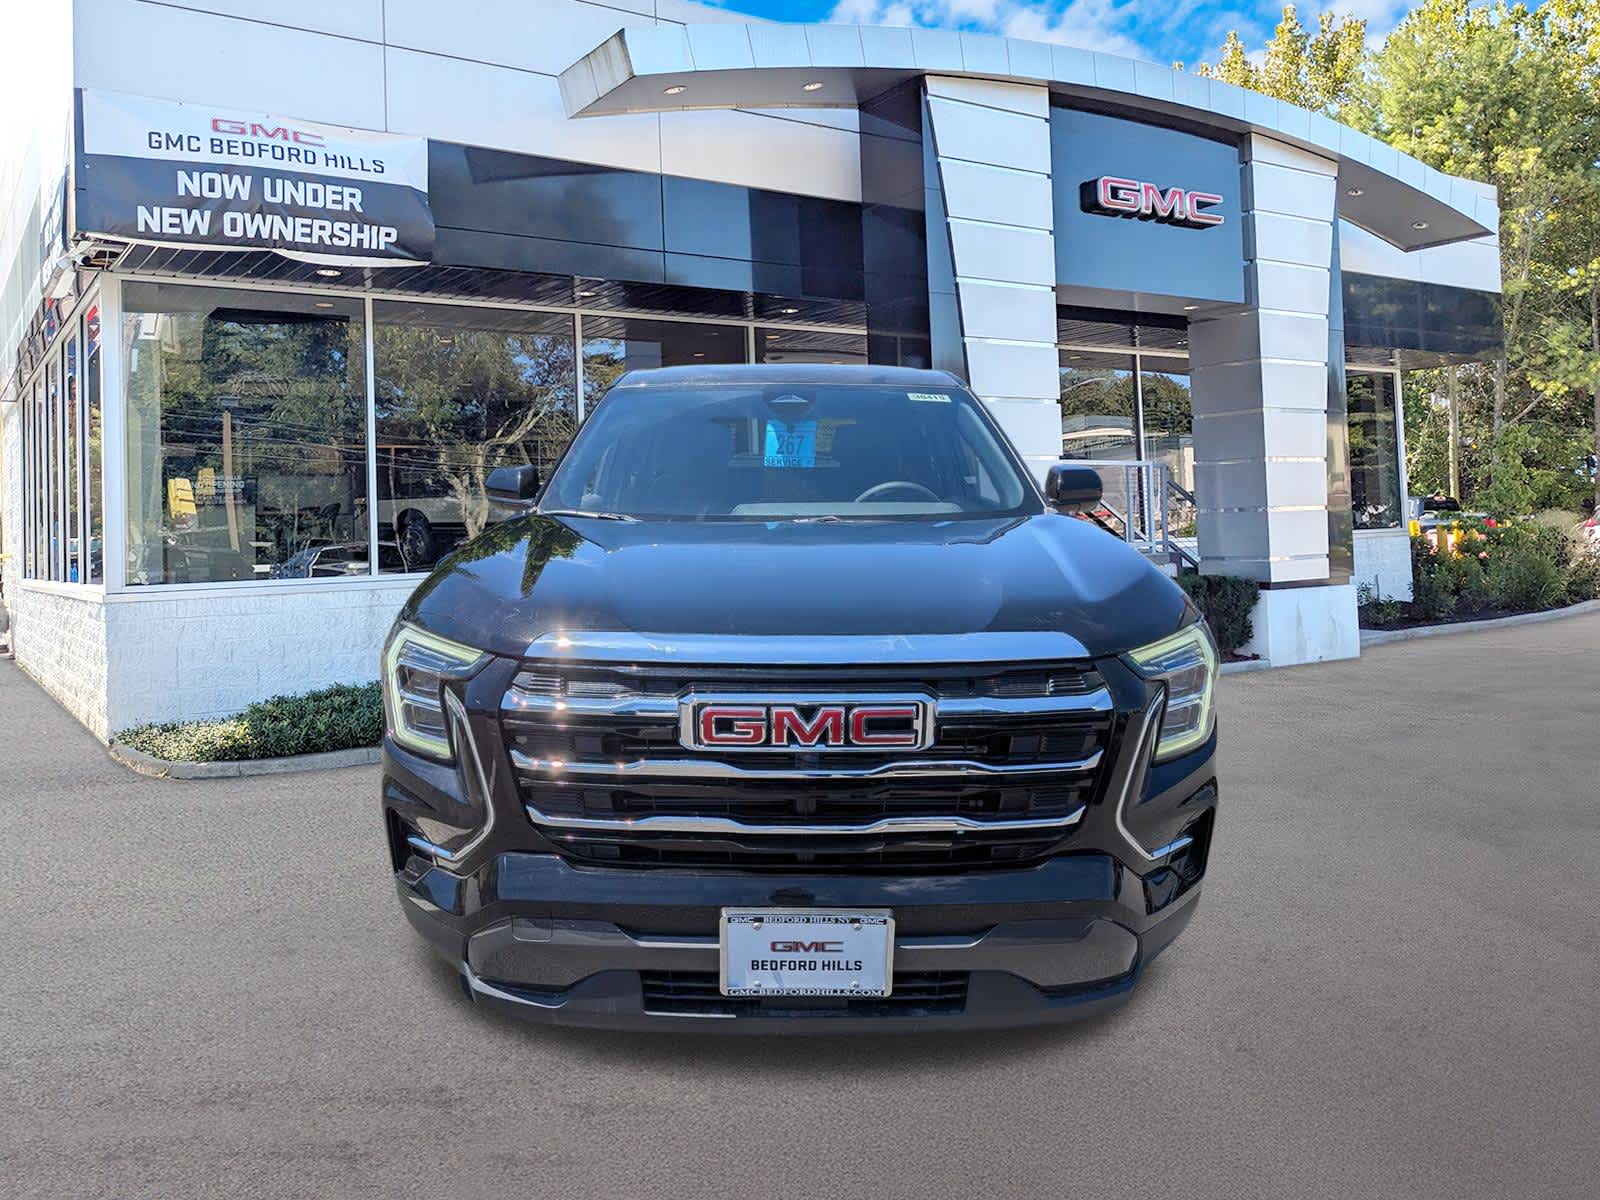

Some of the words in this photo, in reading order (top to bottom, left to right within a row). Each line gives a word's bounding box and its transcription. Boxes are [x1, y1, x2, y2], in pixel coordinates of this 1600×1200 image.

[211, 117, 327, 148] GMC
[148, 131, 201, 153] GMC
[210, 138, 317, 166] BEDFORD
[325, 152, 385, 174] HILLS
[177, 170, 252, 201] NOW
[264, 177, 362, 213] UNDER
[1097, 175, 1225, 225] GMC
[137, 205, 212, 236] NEW
[223, 211, 398, 250] OWNERSHIP
[700, 706, 917, 746] GMC
[730, 916, 755, 924] GMC
[763, 916, 807, 924] BEDFORD
[811, 916, 836, 924] HILLS
[770, 941, 844, 952] GMC
[751, 960, 817, 971] BEDFORD
[822, 960, 863, 971] HILLS
[729, 988, 883, 996] GMCBEDFORDHILLS.COM
